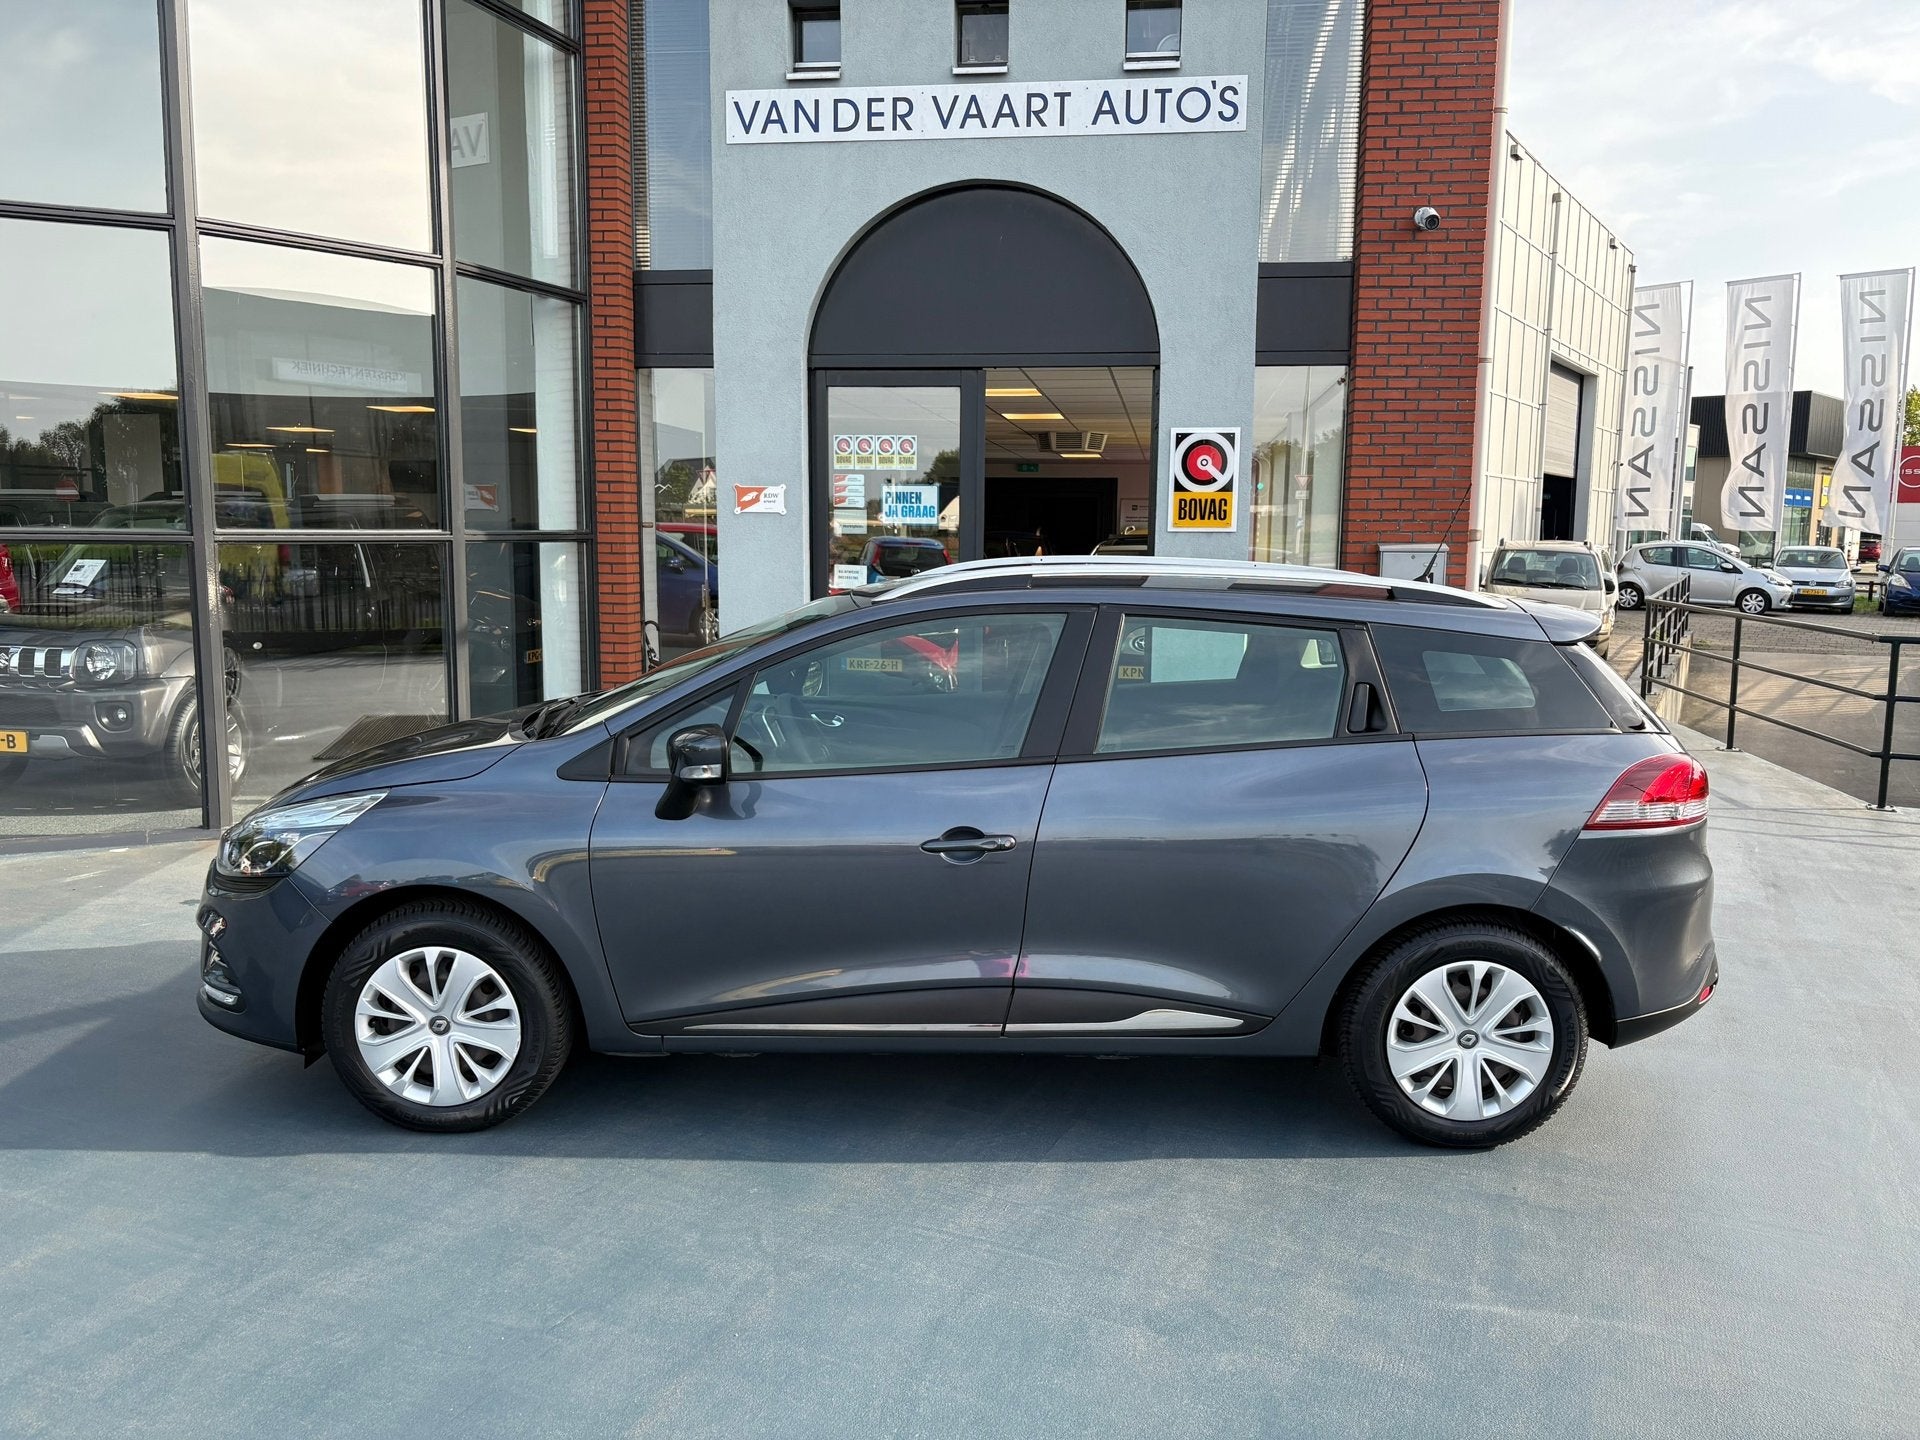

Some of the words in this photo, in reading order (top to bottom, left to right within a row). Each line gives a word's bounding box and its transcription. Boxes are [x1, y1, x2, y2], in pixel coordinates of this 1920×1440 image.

[733, 99, 821, 135] VAN
[832, 96, 915, 133] DER
[931, 91, 1072, 130] VAART
[1091, 80, 1240, 127] AUTO'S
[884, 491, 922, 504] PINNEN
[885, 505, 898, 518] JA
[901, 505, 936, 518] GRAAG
[1177, 498, 1228, 521] BOVAG
[848, 659, 899, 670] KRF-26-H
